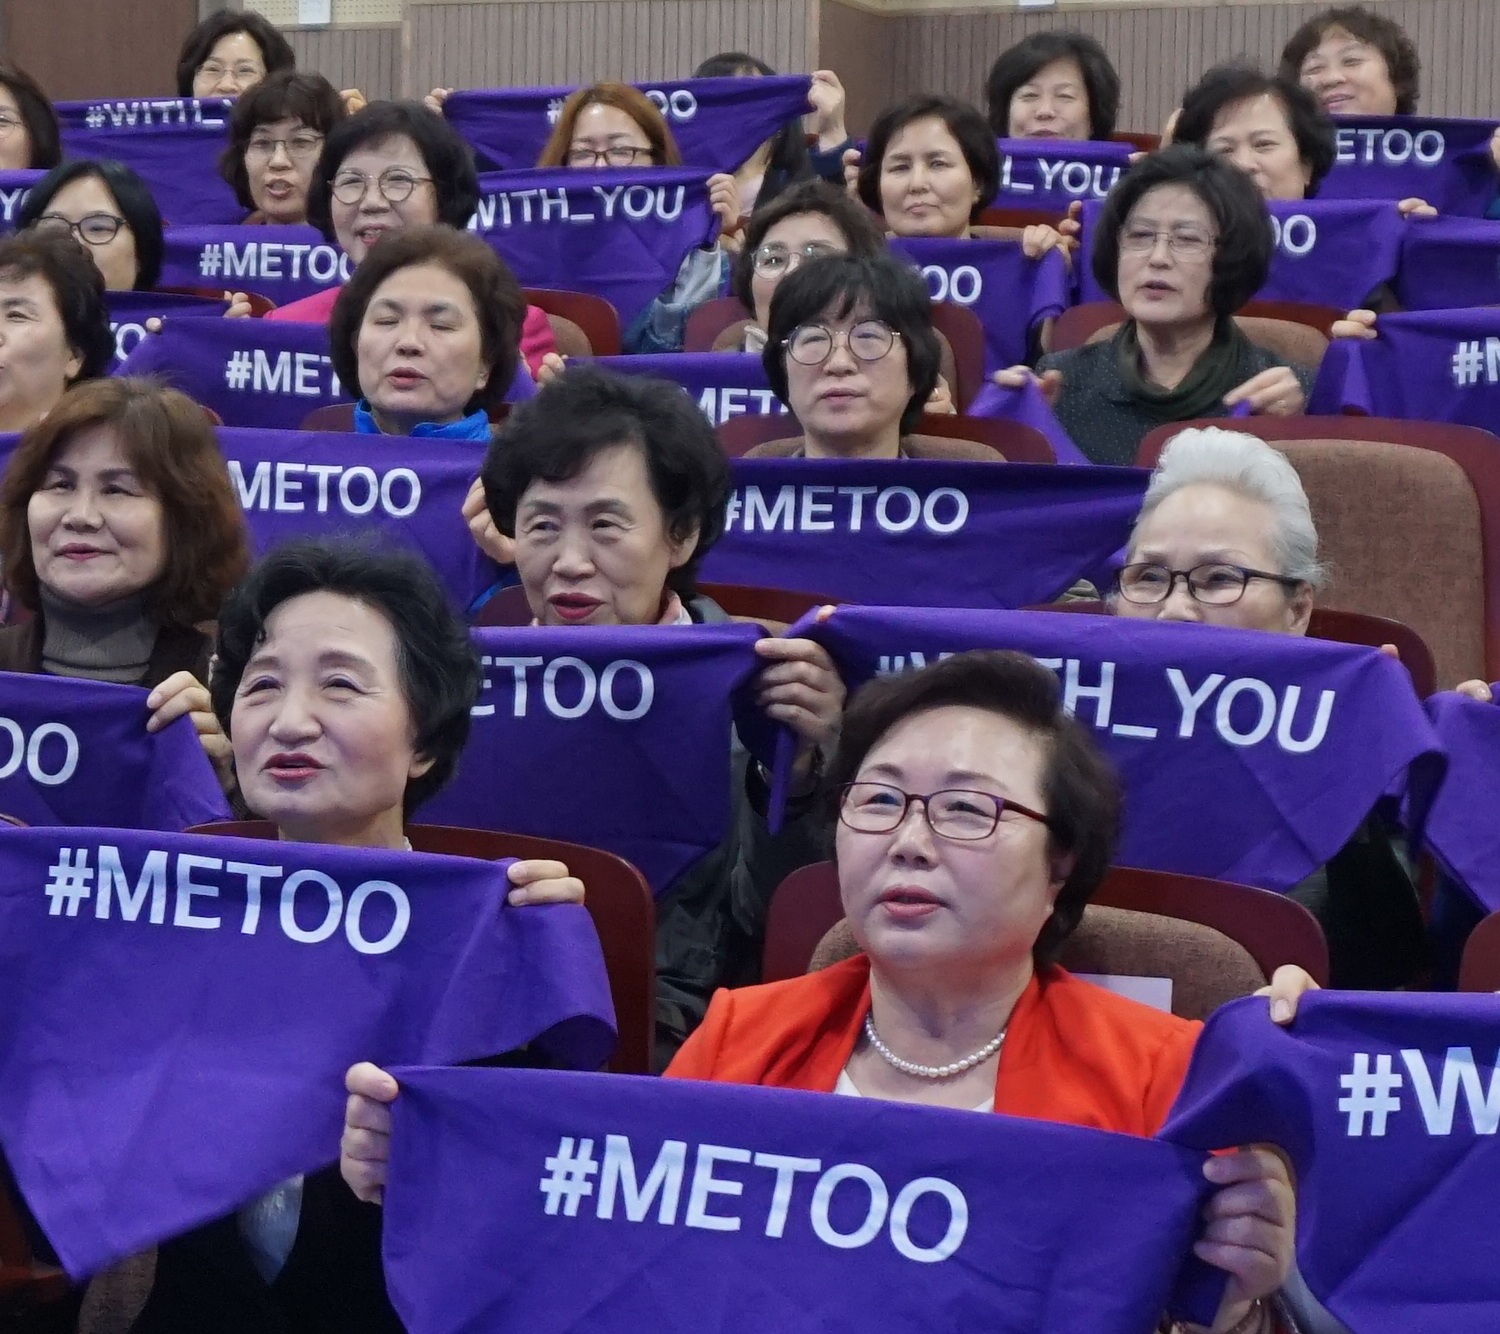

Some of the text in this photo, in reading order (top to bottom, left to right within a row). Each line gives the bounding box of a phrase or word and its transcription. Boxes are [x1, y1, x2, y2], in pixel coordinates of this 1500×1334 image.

[86, 99, 231, 127] #WITH_
[1336, 130, 1444, 162] ETOO
[467, 186, 684, 229] WITH_YOU
[228, 461, 421, 517] METOO
[45, 846, 410, 954] #METOO
[540, 1135, 968, 1262] #METOO
